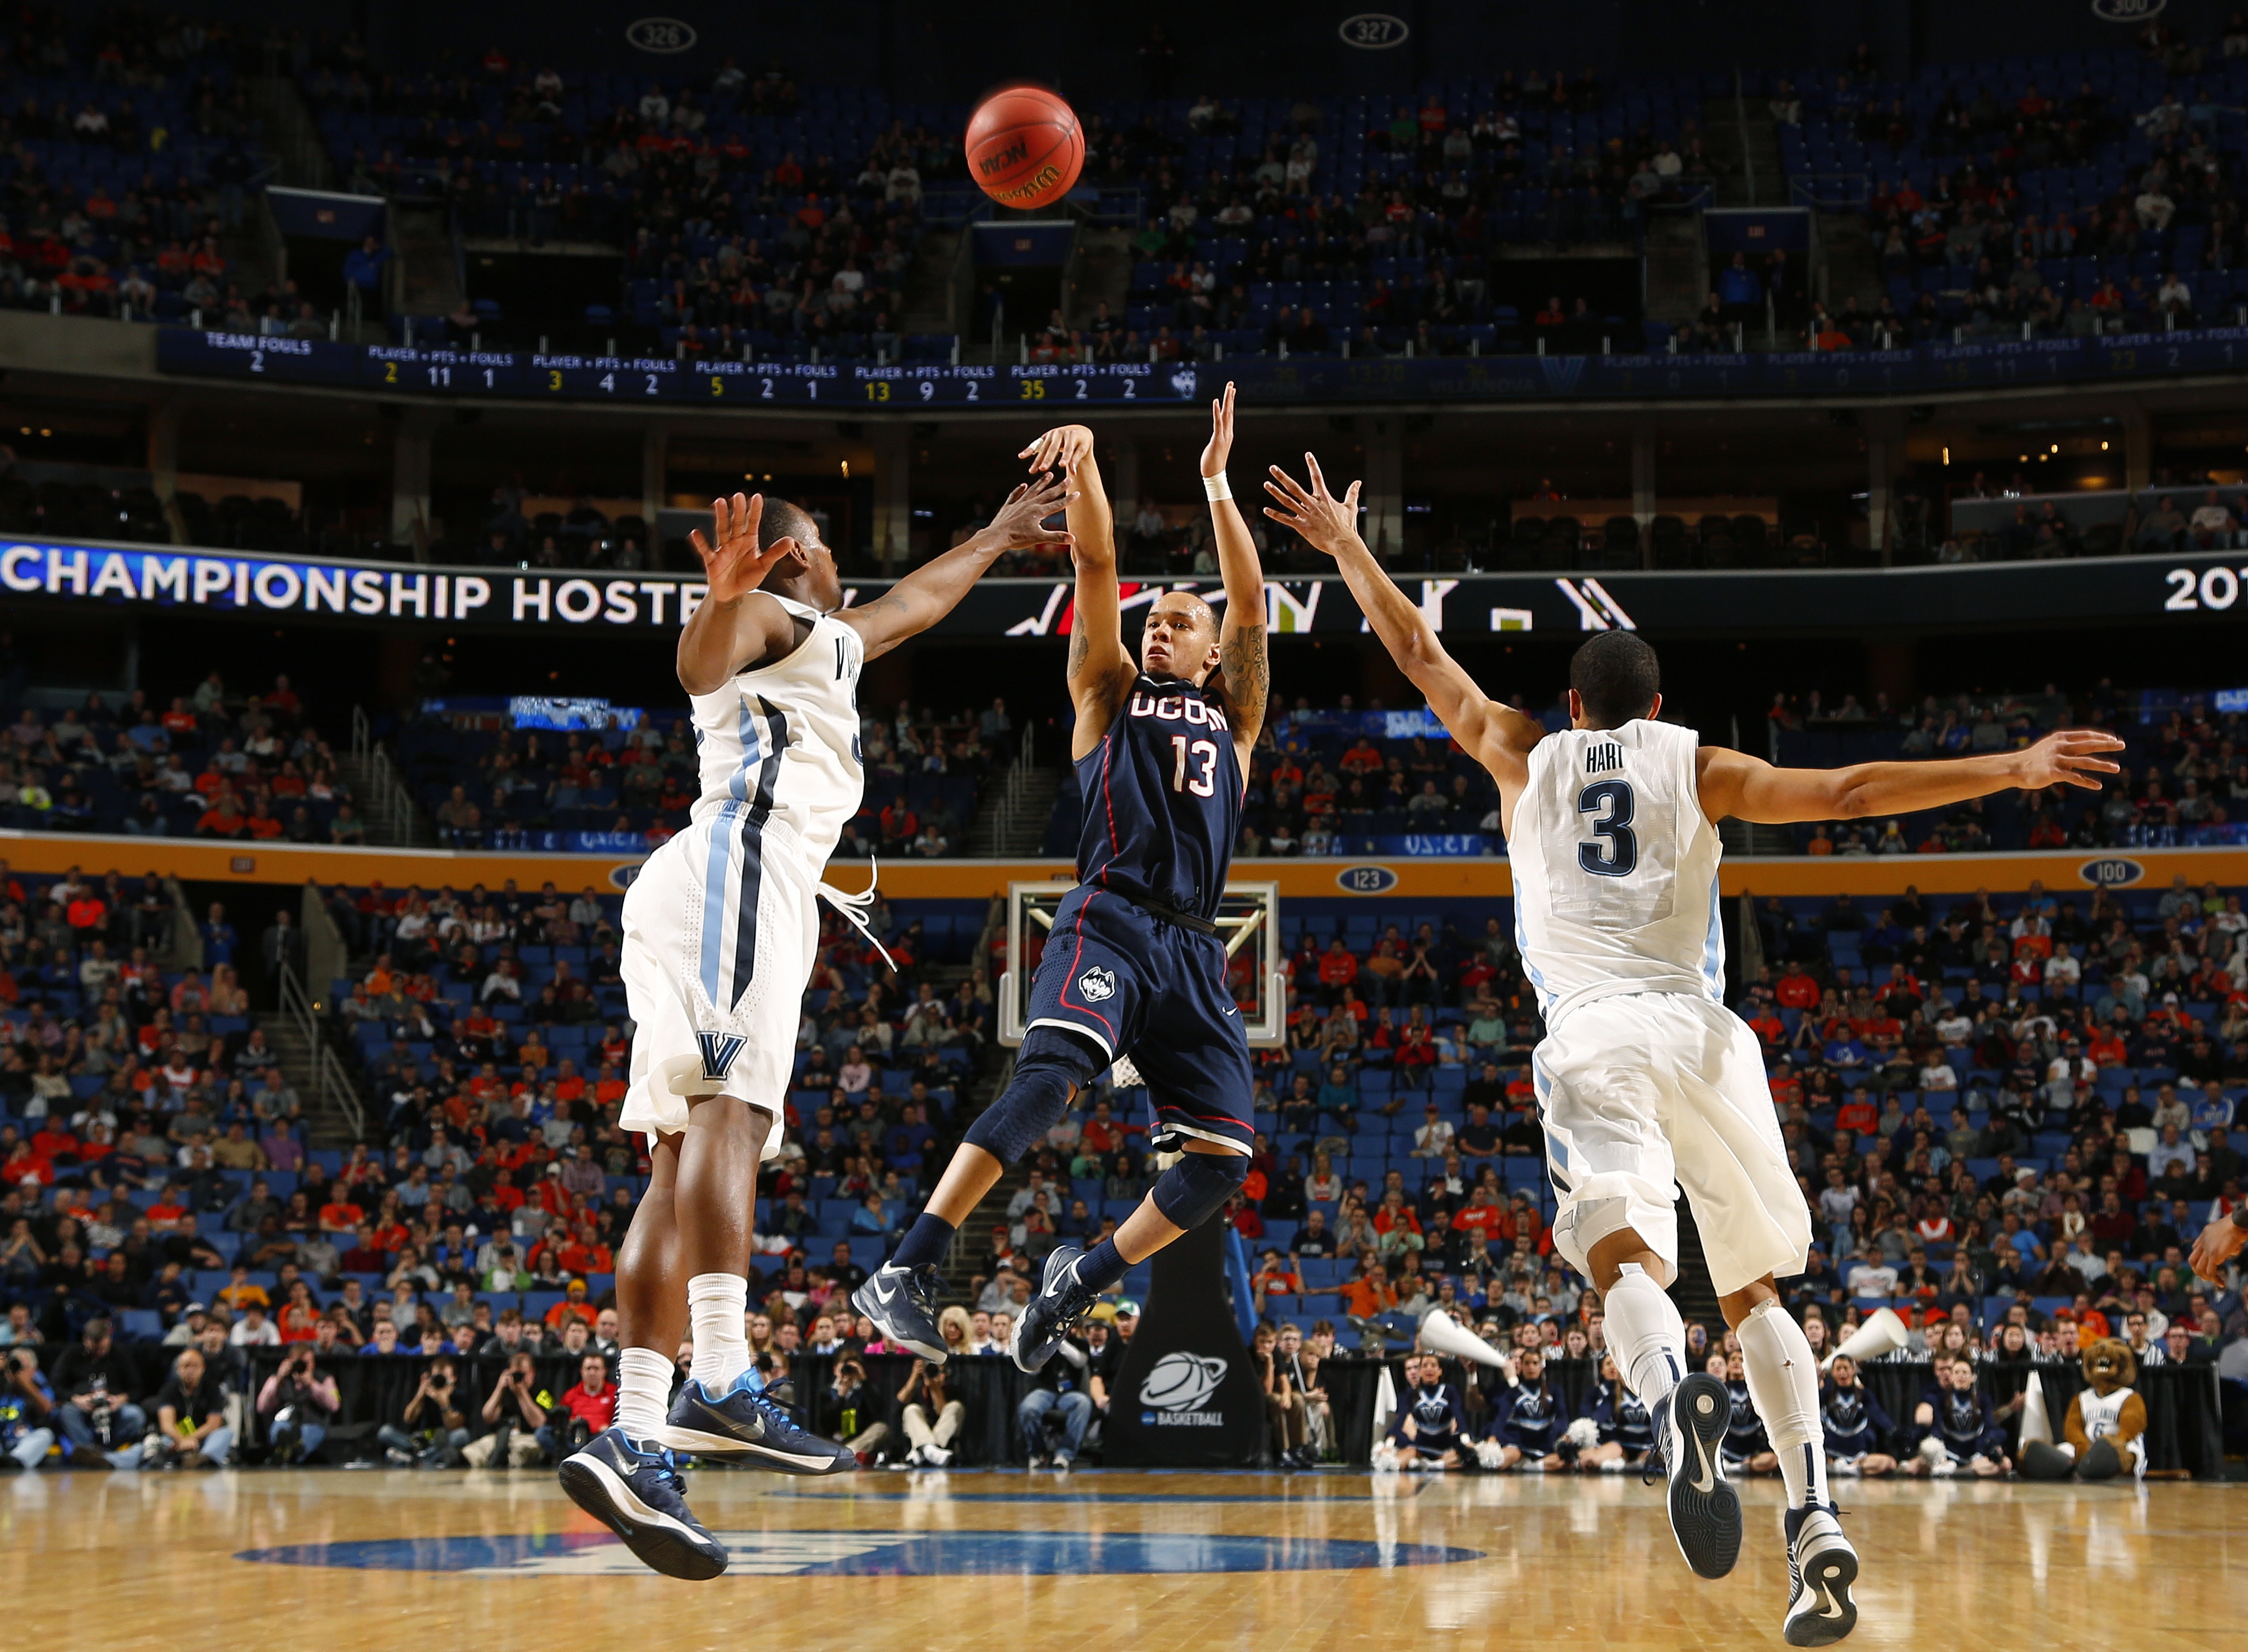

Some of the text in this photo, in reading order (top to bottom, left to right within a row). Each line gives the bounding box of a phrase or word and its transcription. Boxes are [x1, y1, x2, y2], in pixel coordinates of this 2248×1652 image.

[642, 25, 681, 47] 326
[1356, 20, 1392, 43] 327
[979, 142, 1029, 177] NCAA
[205, 331, 312, 355] TEAM FOULS
[249, 351, 265, 372] 2
[368, 345, 514, 367] PLAYER PTS FOULS
[533, 354, 677, 373] PLAYER PTS FOULS
[385, 362, 494, 389] 2 11 1
[695, 361, 838, 378] PLAYER PTS FOULS
[855, 365, 995, 380] PLAYER PTS FOULS
[1011, 363, 1151, 378] PLAYER PTS FOULS
[548, 370, 659, 395] 3 4 2
[711, 376, 817, 400] 5 2 1
[865, 381, 980, 402] 13 9 2
[1020, 378, 1136, 400] 35 2 2
[1, 545, 491, 620] CHAMPIONSHIP
[1170, 734, 1218, 798] 13
[1586, 742, 1624, 772] HART
[1578, 779, 1636, 877] 3
[1354, 870, 1380, 888] 123
[2097, 862, 2126, 881] 100
[696, 1030, 748, 1081] V
[1157, 1411, 1224, 1426] BASKETBALL
